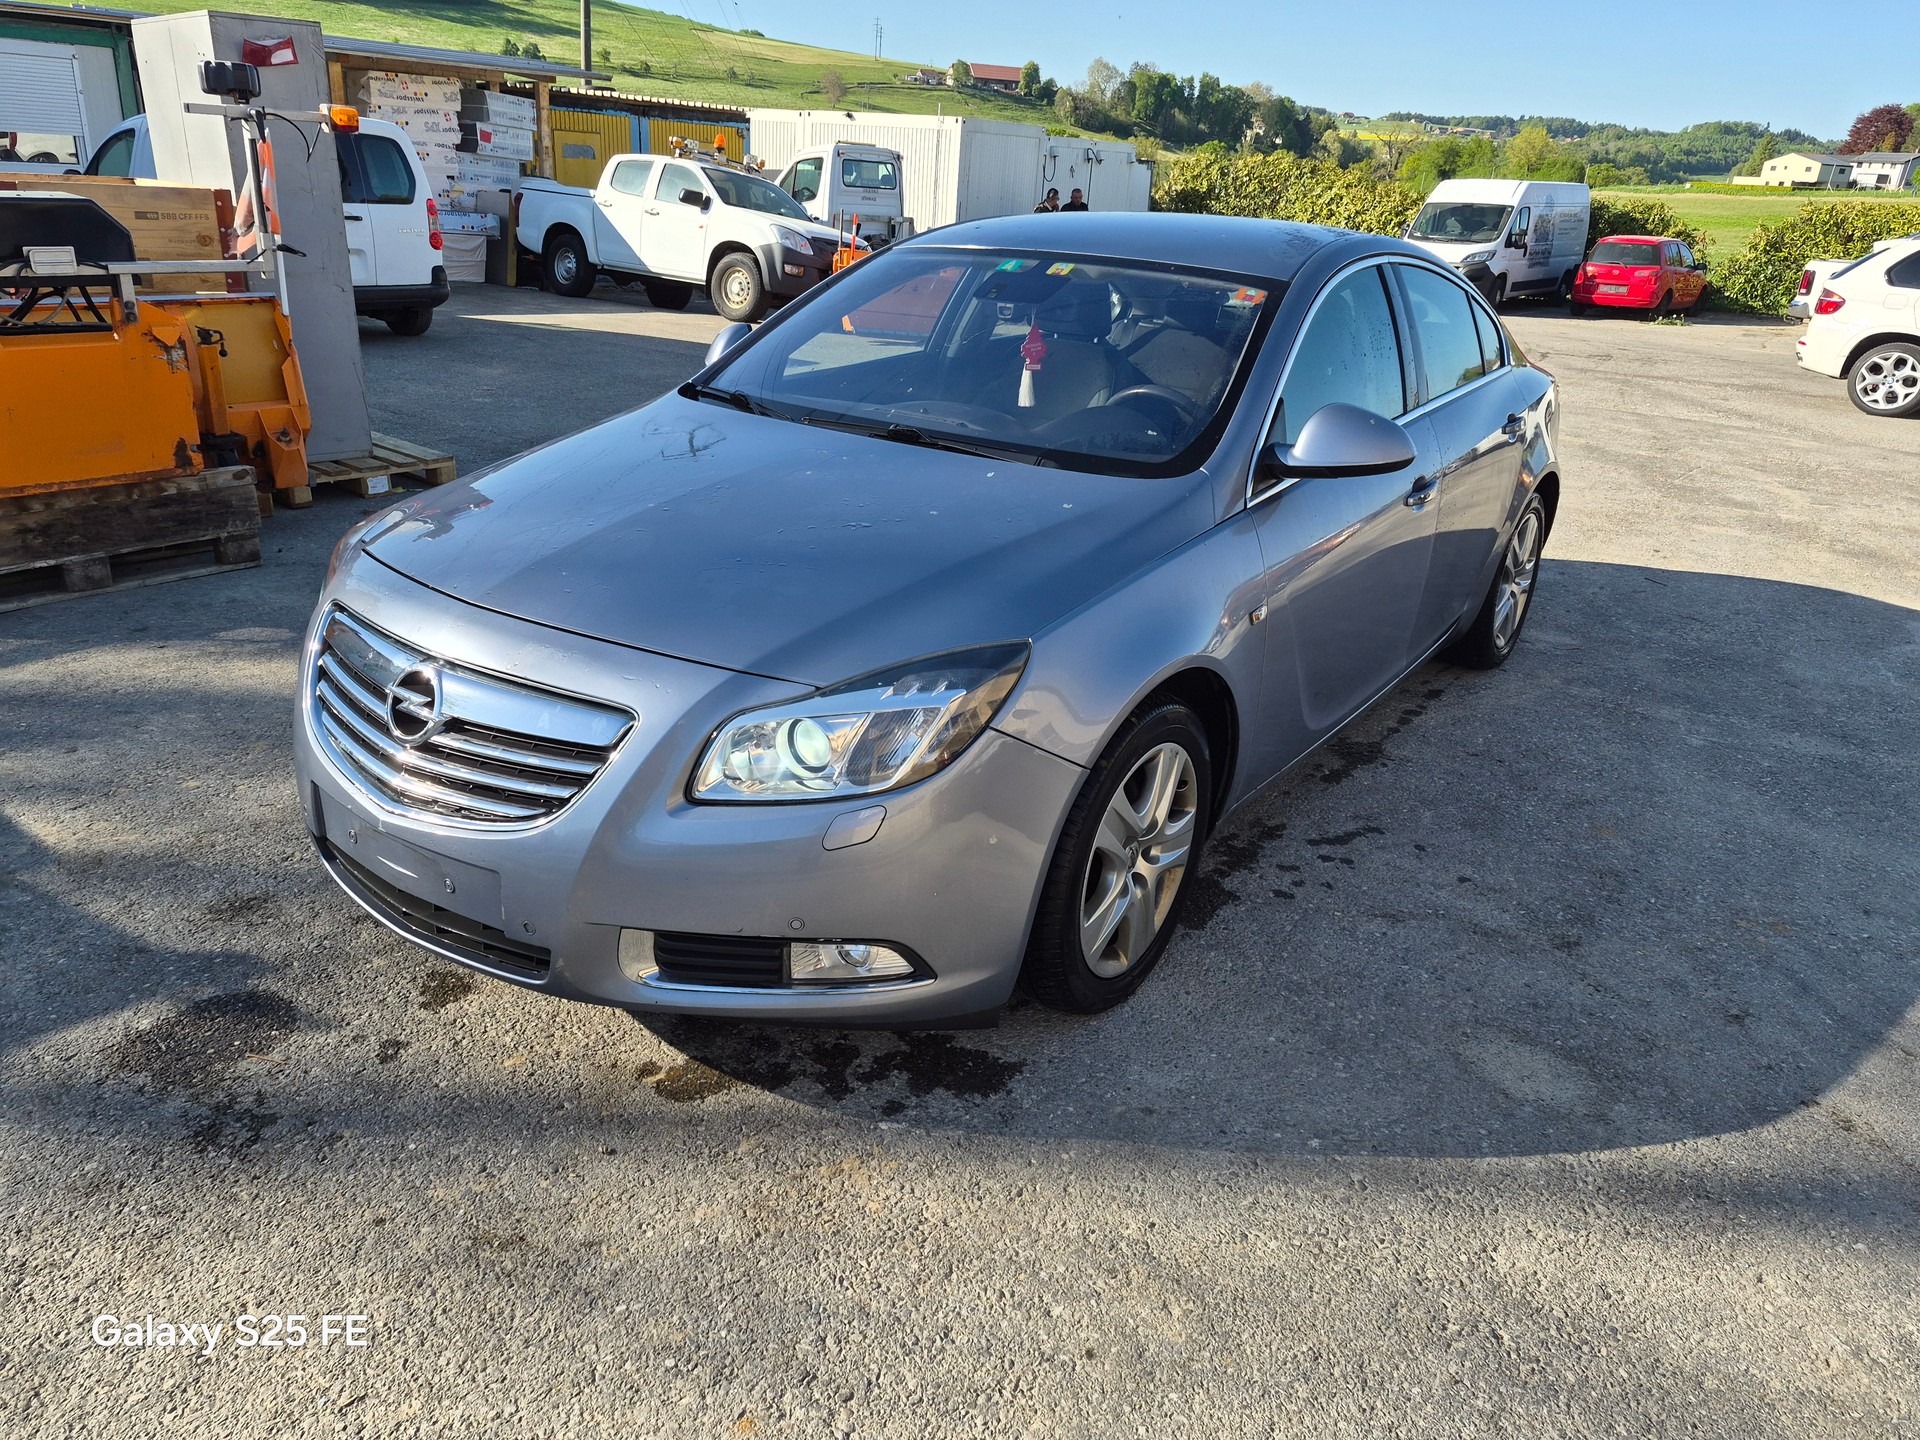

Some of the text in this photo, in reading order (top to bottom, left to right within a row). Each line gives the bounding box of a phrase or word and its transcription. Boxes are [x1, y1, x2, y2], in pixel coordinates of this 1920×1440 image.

[396, 94, 425, 104] swisspor
[413, 109, 440, 117] swisspor
[424, 120, 442, 133] XPS
[161, 212, 177, 220] SBB
[195, 213, 210, 221] FFS
